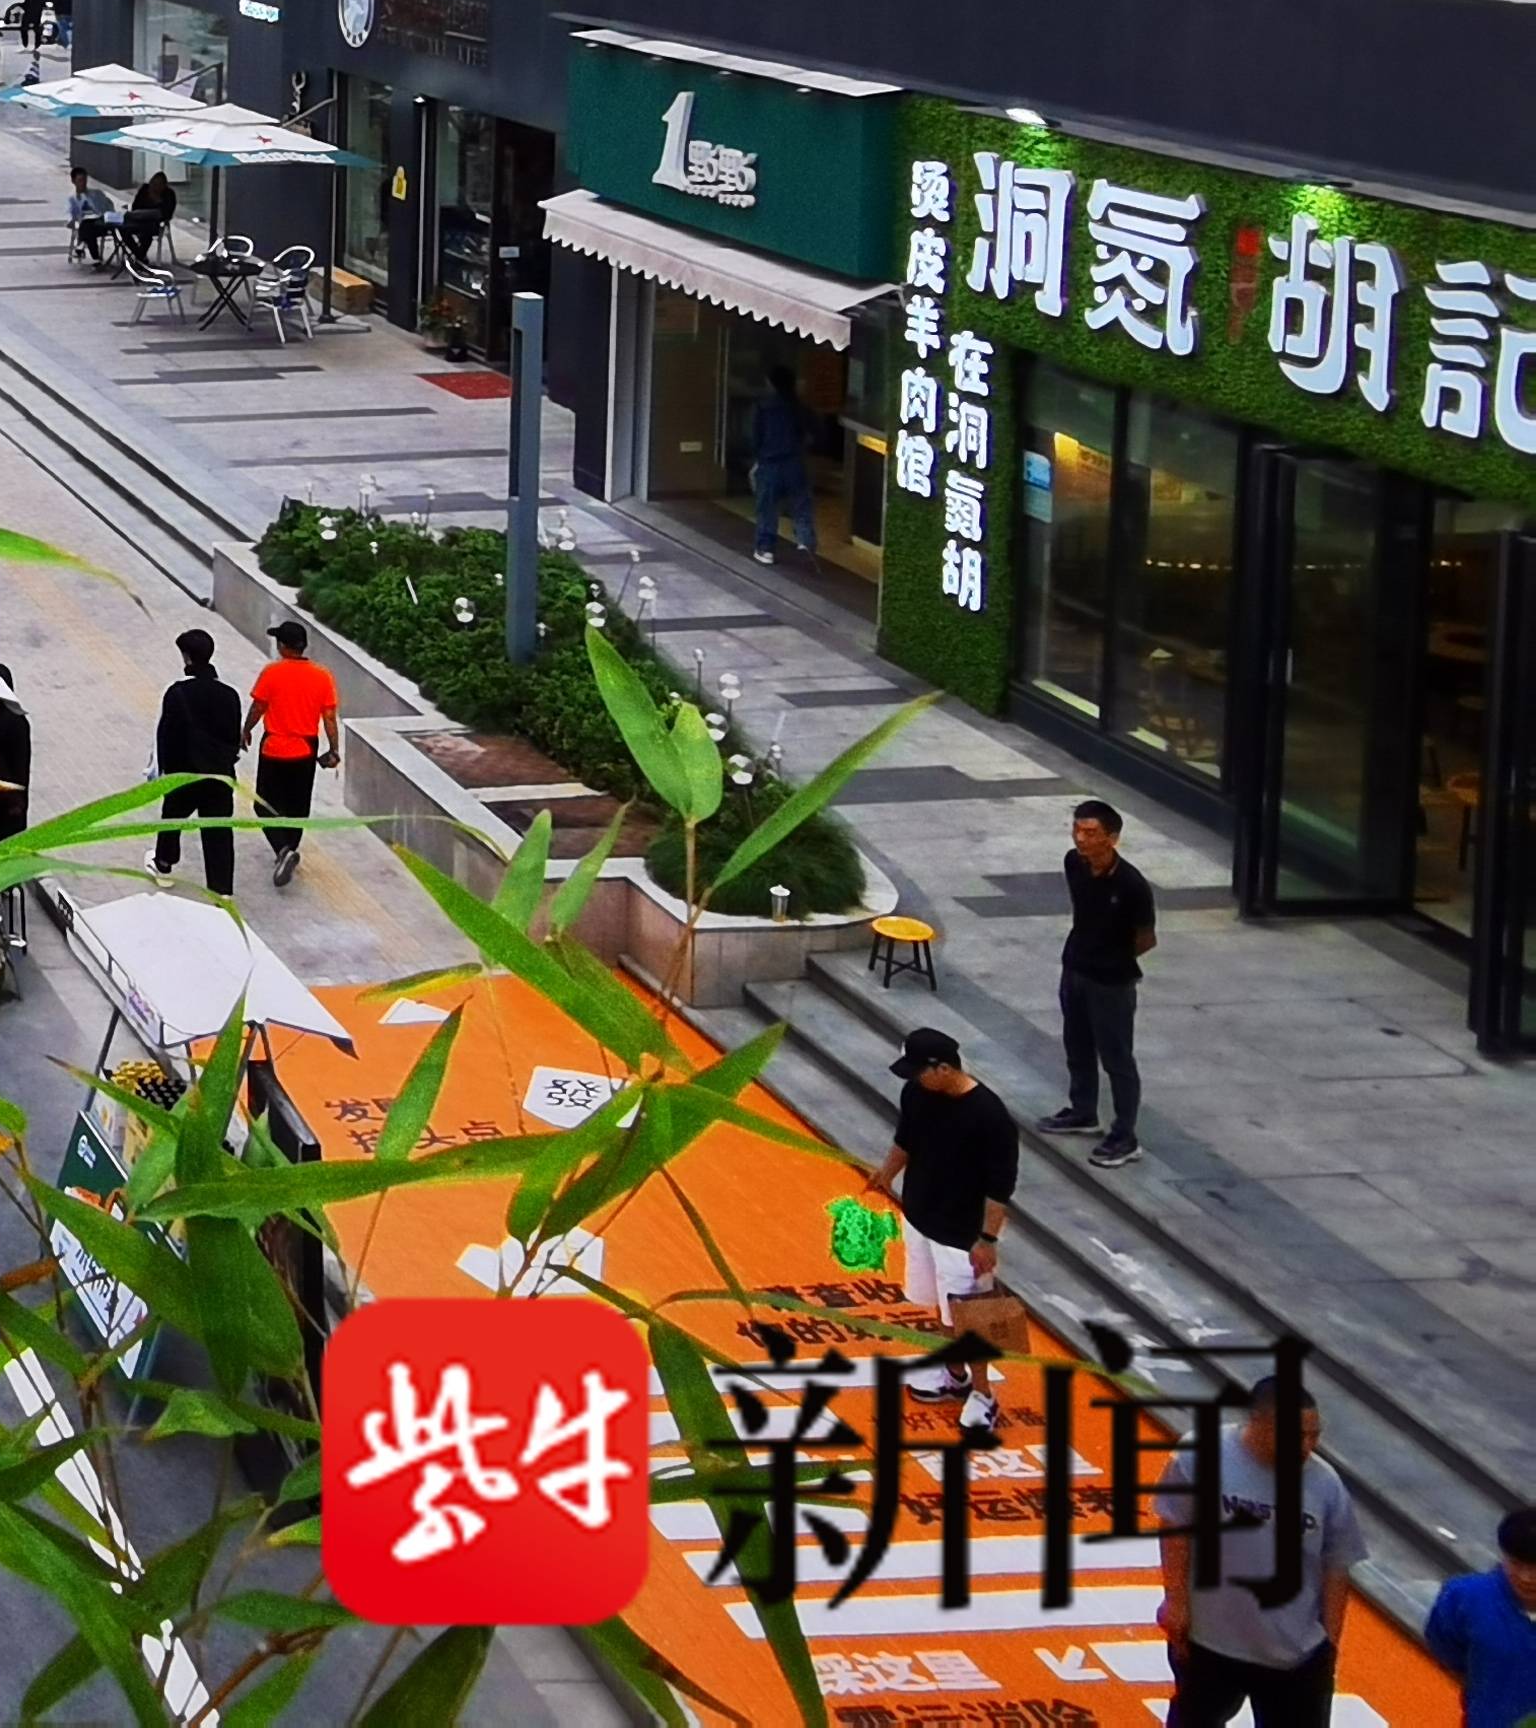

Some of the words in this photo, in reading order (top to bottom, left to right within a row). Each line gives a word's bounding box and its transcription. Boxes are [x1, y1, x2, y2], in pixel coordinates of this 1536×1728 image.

[895, 160, 953, 498] 烫皮羊肉馆
